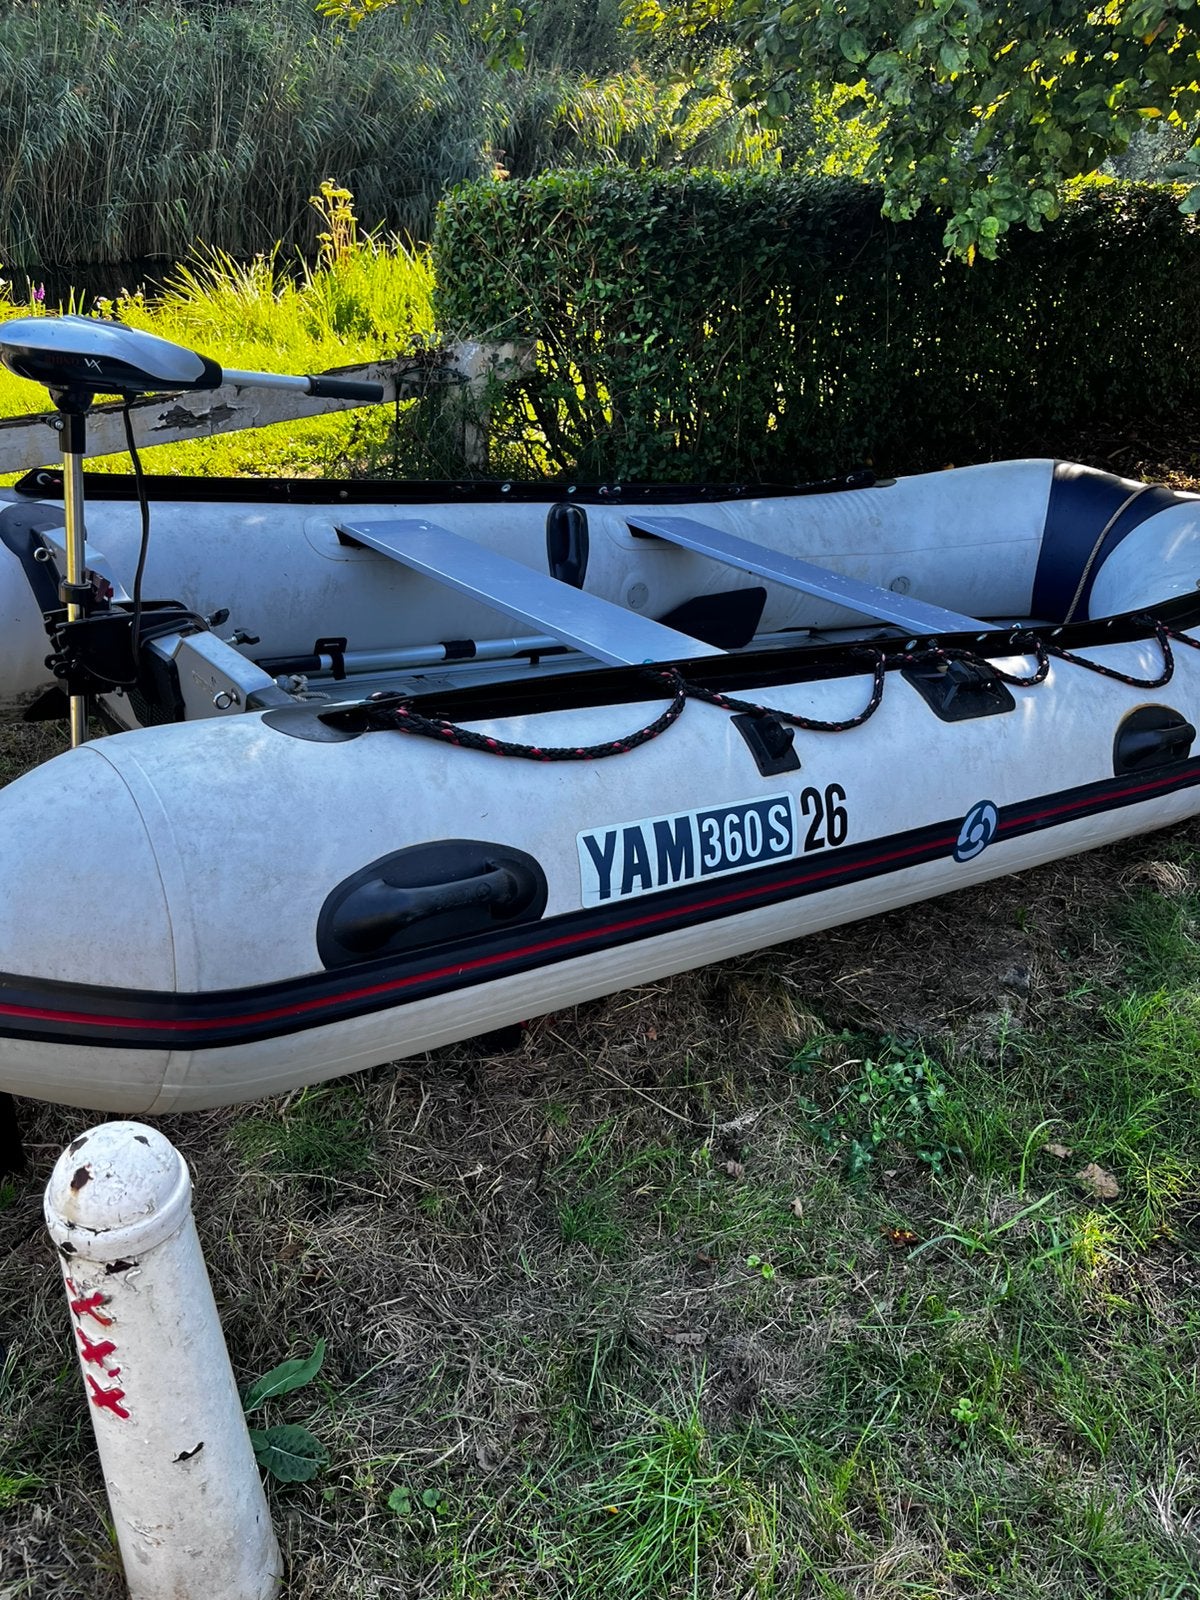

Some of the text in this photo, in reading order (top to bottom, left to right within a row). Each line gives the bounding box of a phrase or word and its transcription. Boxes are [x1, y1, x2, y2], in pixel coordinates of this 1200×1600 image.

[84, 358, 103, 374] VX
[582, 816, 695, 901] YAM
[800, 783, 848, 852] 26
